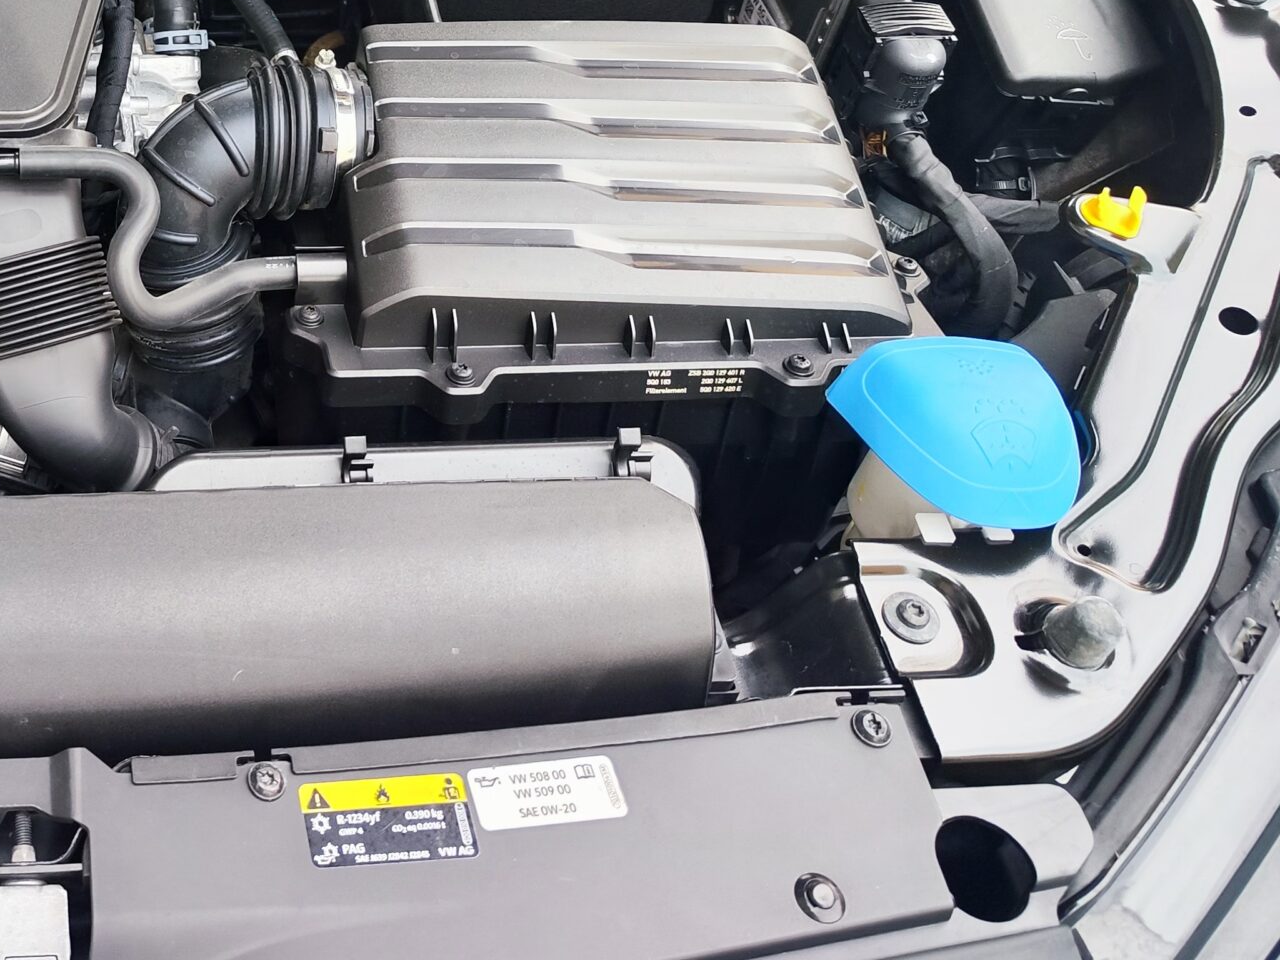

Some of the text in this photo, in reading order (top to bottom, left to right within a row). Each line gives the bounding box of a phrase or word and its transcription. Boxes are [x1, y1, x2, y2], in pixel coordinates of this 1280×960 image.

[645, 386, 688, 395] Filterelement
[509, 769, 567, 785] VW 508 00
[513, 784, 572, 799] VW 509 00
[335, 808, 444, 826] R-1234yf 0.390 kg
[519, 803, 577, 818] SAE 0W-20
[341, 843, 366, 855] PAG
[437, 845, 475, 857] VW AG
[355, 854, 370, 863] SAE
